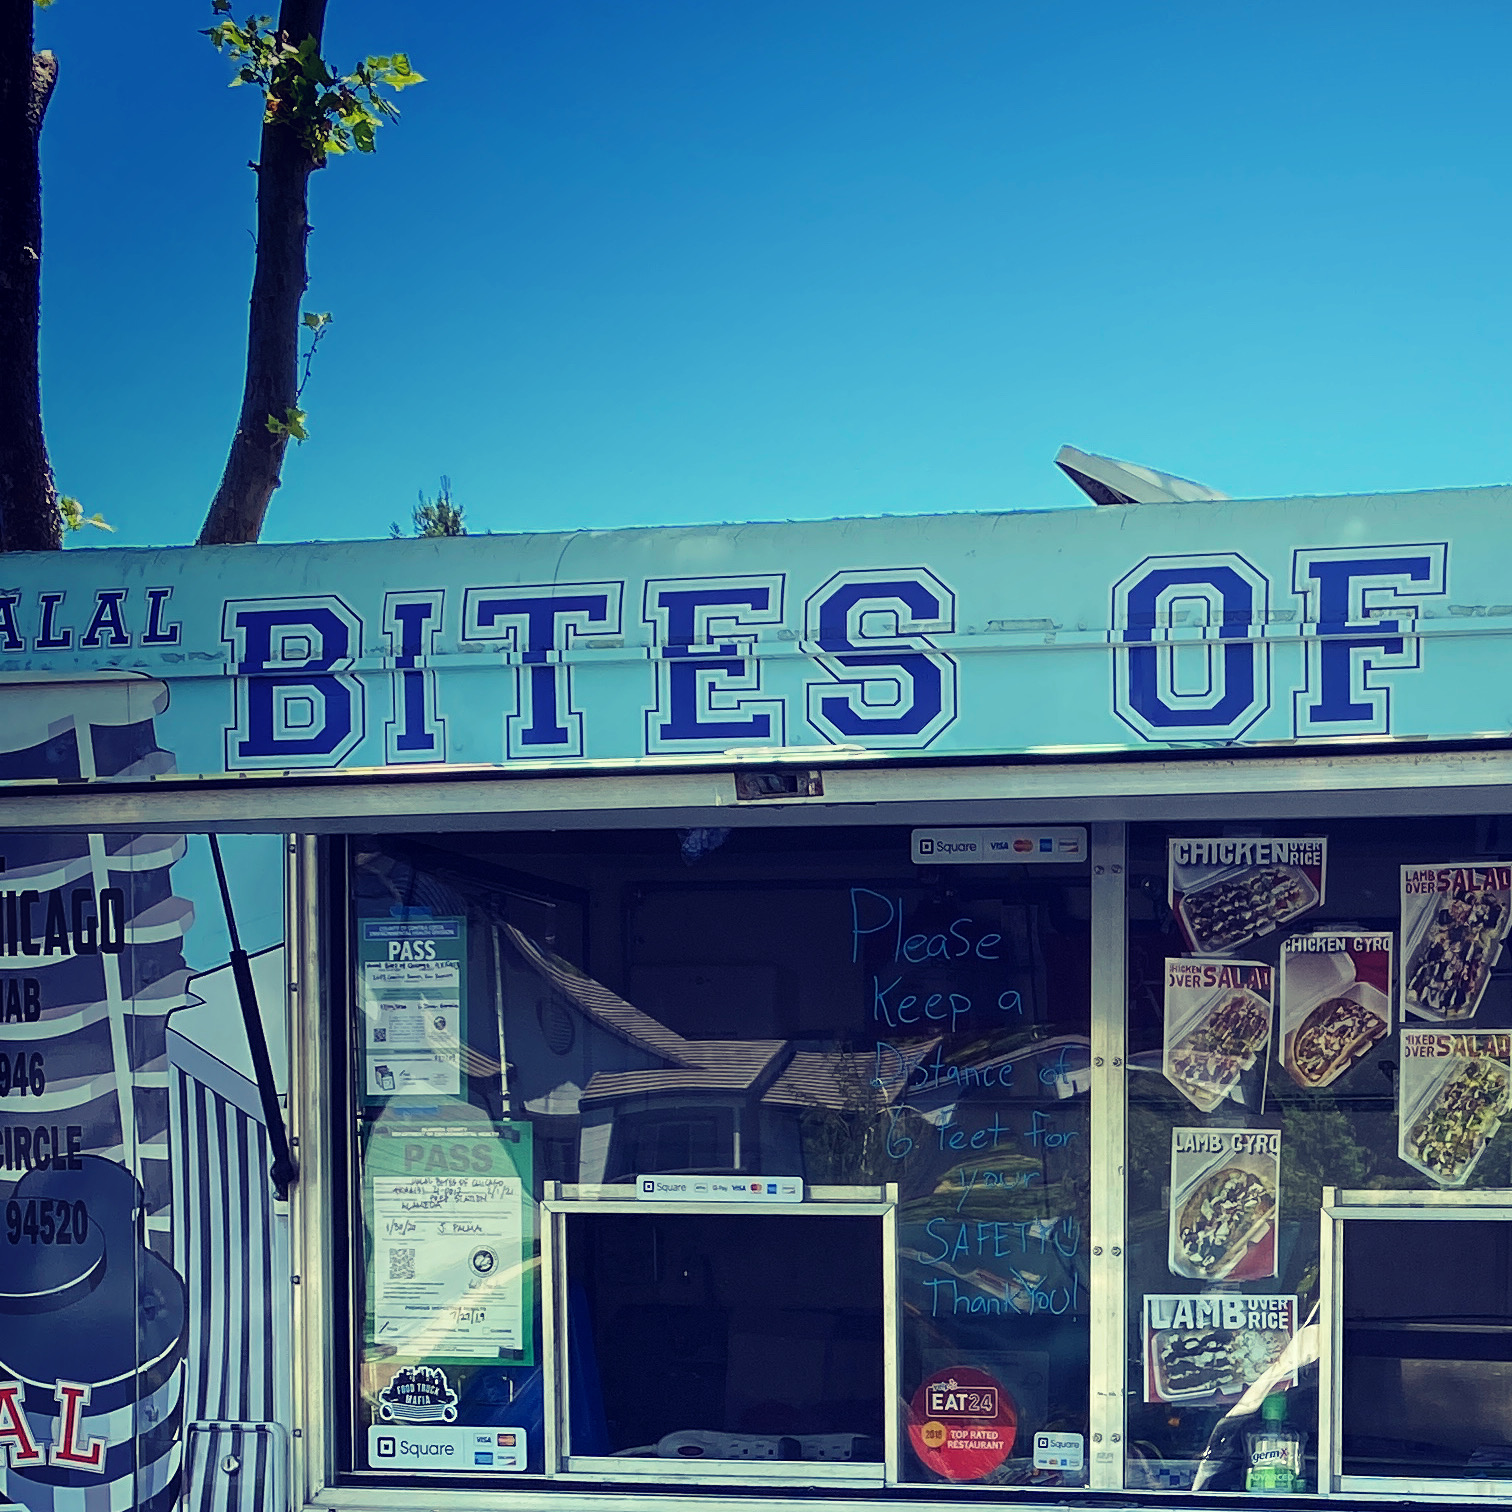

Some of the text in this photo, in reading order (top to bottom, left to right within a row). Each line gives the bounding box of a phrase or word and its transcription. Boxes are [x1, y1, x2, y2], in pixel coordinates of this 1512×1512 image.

[0, 587, 182, 653] ALAL
[222, 568, 957, 771] BITES
[1108, 542, 1448, 743] OF
[937, 840, 977, 856] Square
[1177, 841, 1289, 865] CHICKEN
[1289, 842, 1321, 851] OVER
[1289, 852, 1321, 866] RICE
[1406, 870, 1434, 881] LAMB
[1437, 867, 1512, 893] SALAD
[1406, 882, 1434, 894] OVER
[0, 887, 125, 957] ICAGO
[850, 886, 1002, 963] Please
[388, 939, 437, 961] PASS
[1284, 938, 1346, 953] CHICKEN
[0, 978, 41, 1023] AB
[873, 975, 1023, 1034] Keep a
[886, 1103, 913, 1159] 6
[0, 1125, 83, 1171] IRCLE
[1176, 1134, 1222, 1154] LAMB
[404, 1144, 493, 1172] PASS
[656, 1182, 687, 1193] Square
[6, 1200, 88, 1245] 94520
[923, 1276, 1022, 1317] Thank
[1248, 1300, 1289, 1311] OVER
[1150, 1299, 1247, 1330] LAMB
[1248, 1312, 1289, 1330] RICE
[397, 1383, 440, 1396] FOOD TRUCK
[406, 1395, 430, 1405] MAFIA
[932, 1393, 993, 1412] EAT24
[950, 1430, 968, 1440] TOP
[970, 1430, 998, 1440] RATED
[400, 1440, 455, 1459] Square
[947, 1440, 1005, 1450] RESTAURANT
[1050, 1440, 1080, 1450] Square
